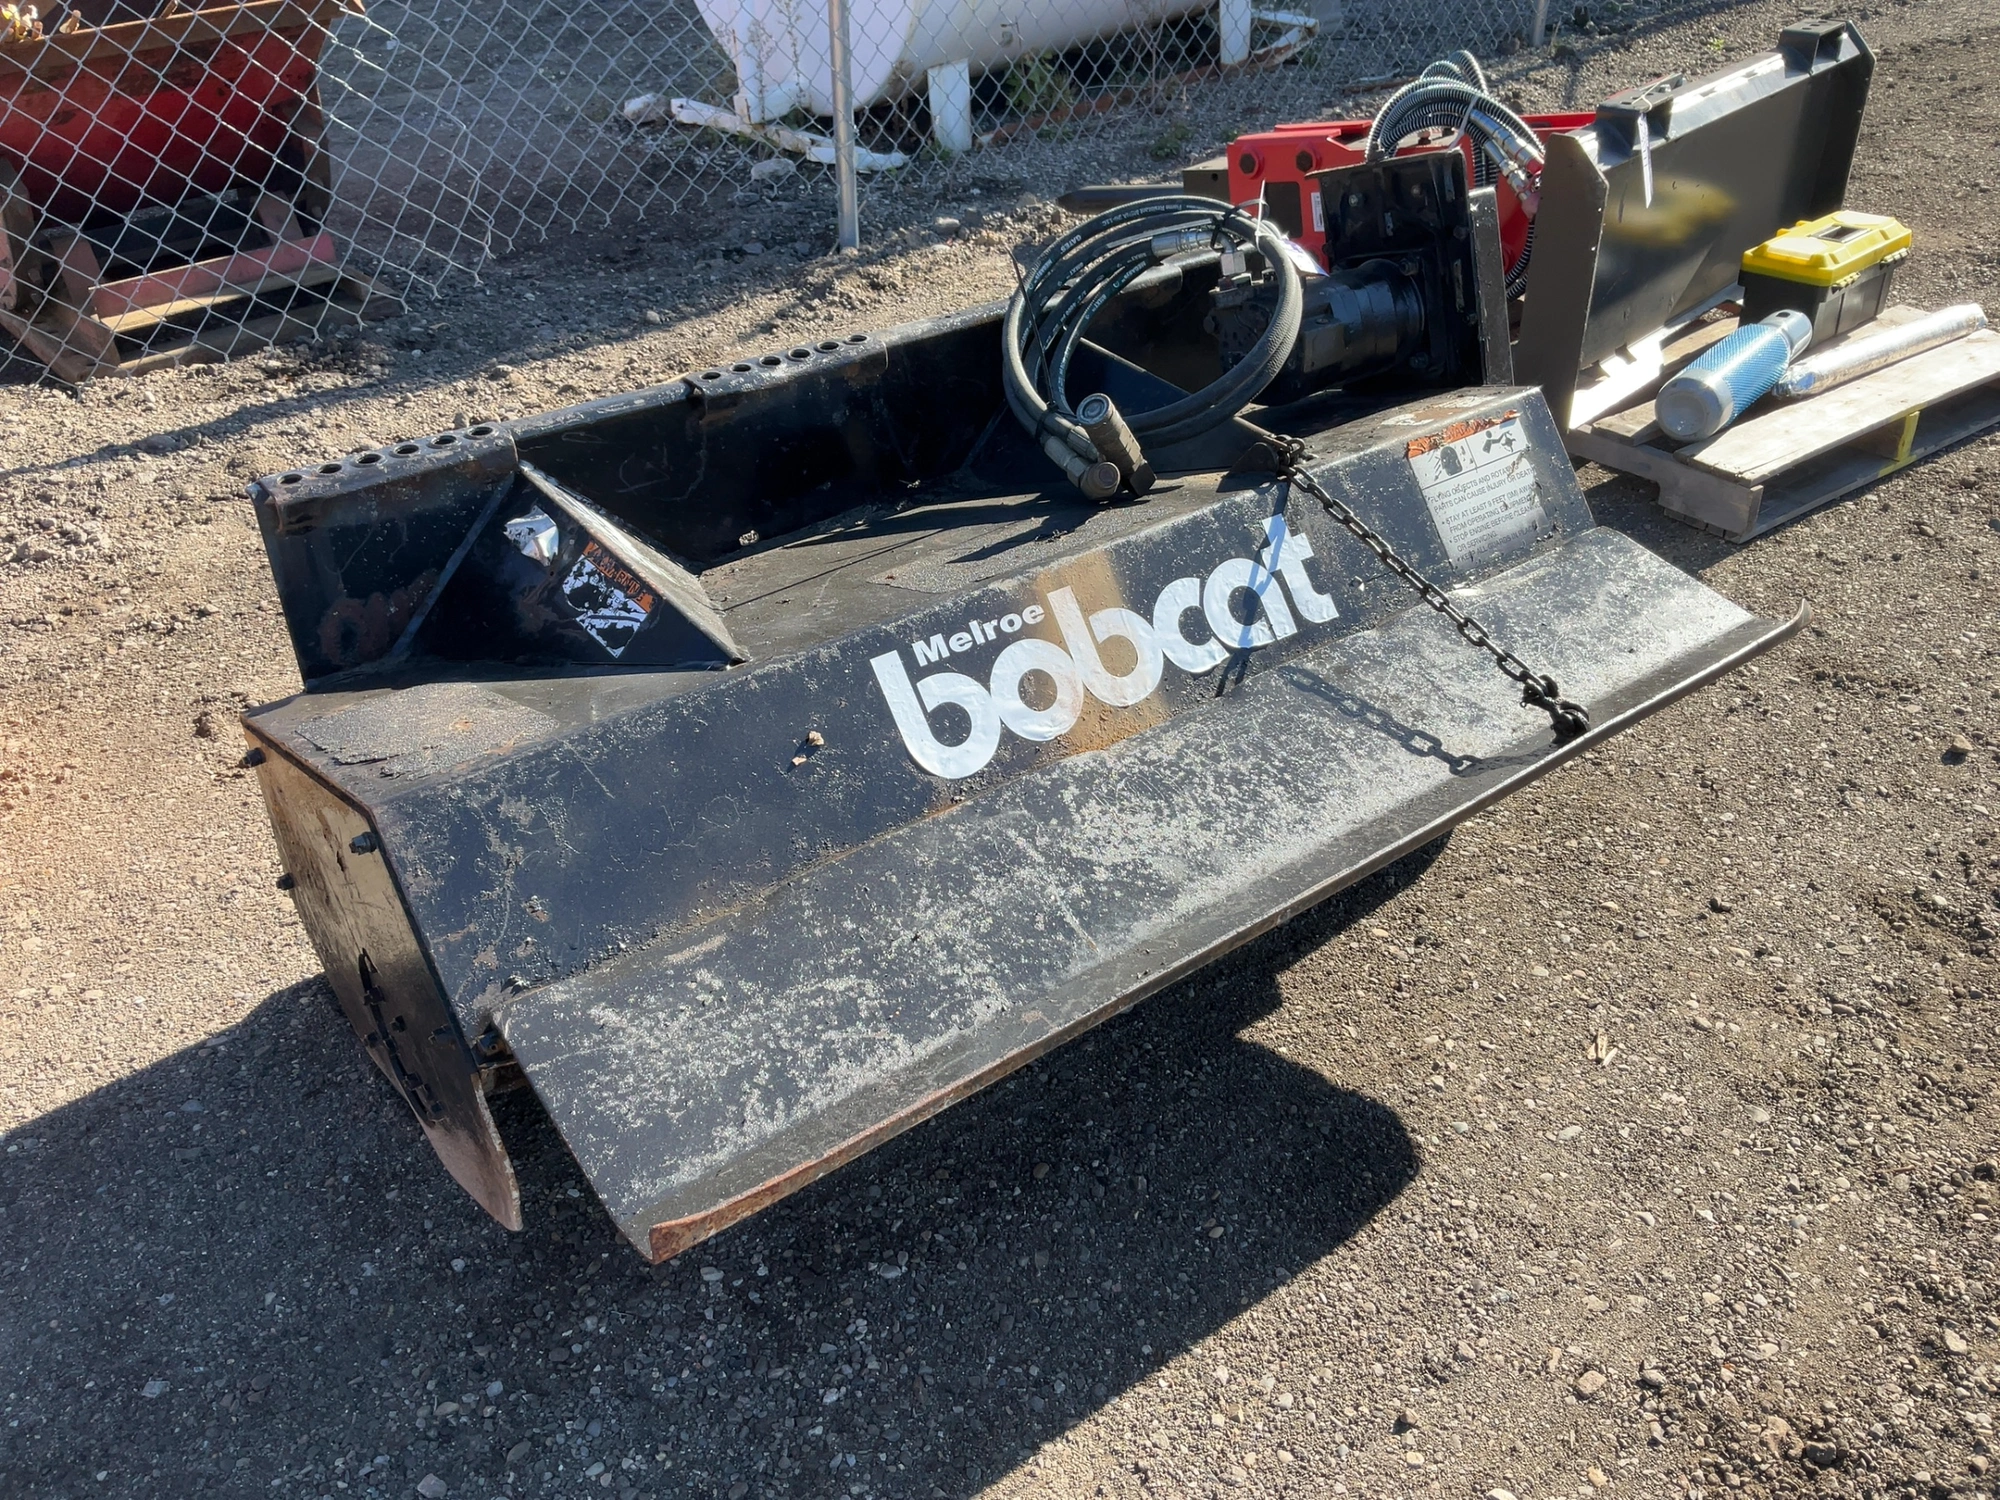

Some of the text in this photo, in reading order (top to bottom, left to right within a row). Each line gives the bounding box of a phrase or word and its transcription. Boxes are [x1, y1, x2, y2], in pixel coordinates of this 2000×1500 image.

[1059, 232, 1082, 253] GATES
[1429, 489, 1451, 504] FLYING
[1450, 478, 1478, 495] OBJECTS
[1477, 473, 1491, 484] AND
[1433, 499, 1454, 512] PARTS
[1453, 494, 1467, 504] CAN
[1465, 486, 1487, 499] CAUSE
[1485, 478, 1507, 491] INJURY
[1506, 474, 1516, 483] OR
[1444, 512, 1461, 524] STAY
[1460, 509, 1469, 518] AT
[1468, 501, 1487, 514] LEAST
[1491, 494, 1507, 505] FEET
[1518, 482, 1536, 494] AWAY
[1448, 520, 1467, 533] FROM
[1466, 507, 1500, 526] OPERATING
[1452, 530, 1469, 542] STOP
[1468, 521, 1491, 535] ENGINE
[1489, 512, 1513, 527] BEFORE
[1456, 542, 1467, 552] OR
[1475, 544, 1489, 554] ALL
[1488, 534, 1511, 549] GUARDS
[1510, 531, 1519, 539] IN
[870, 513, 1339, 779] bobcat
[912, 603, 1046, 667] Melroe
